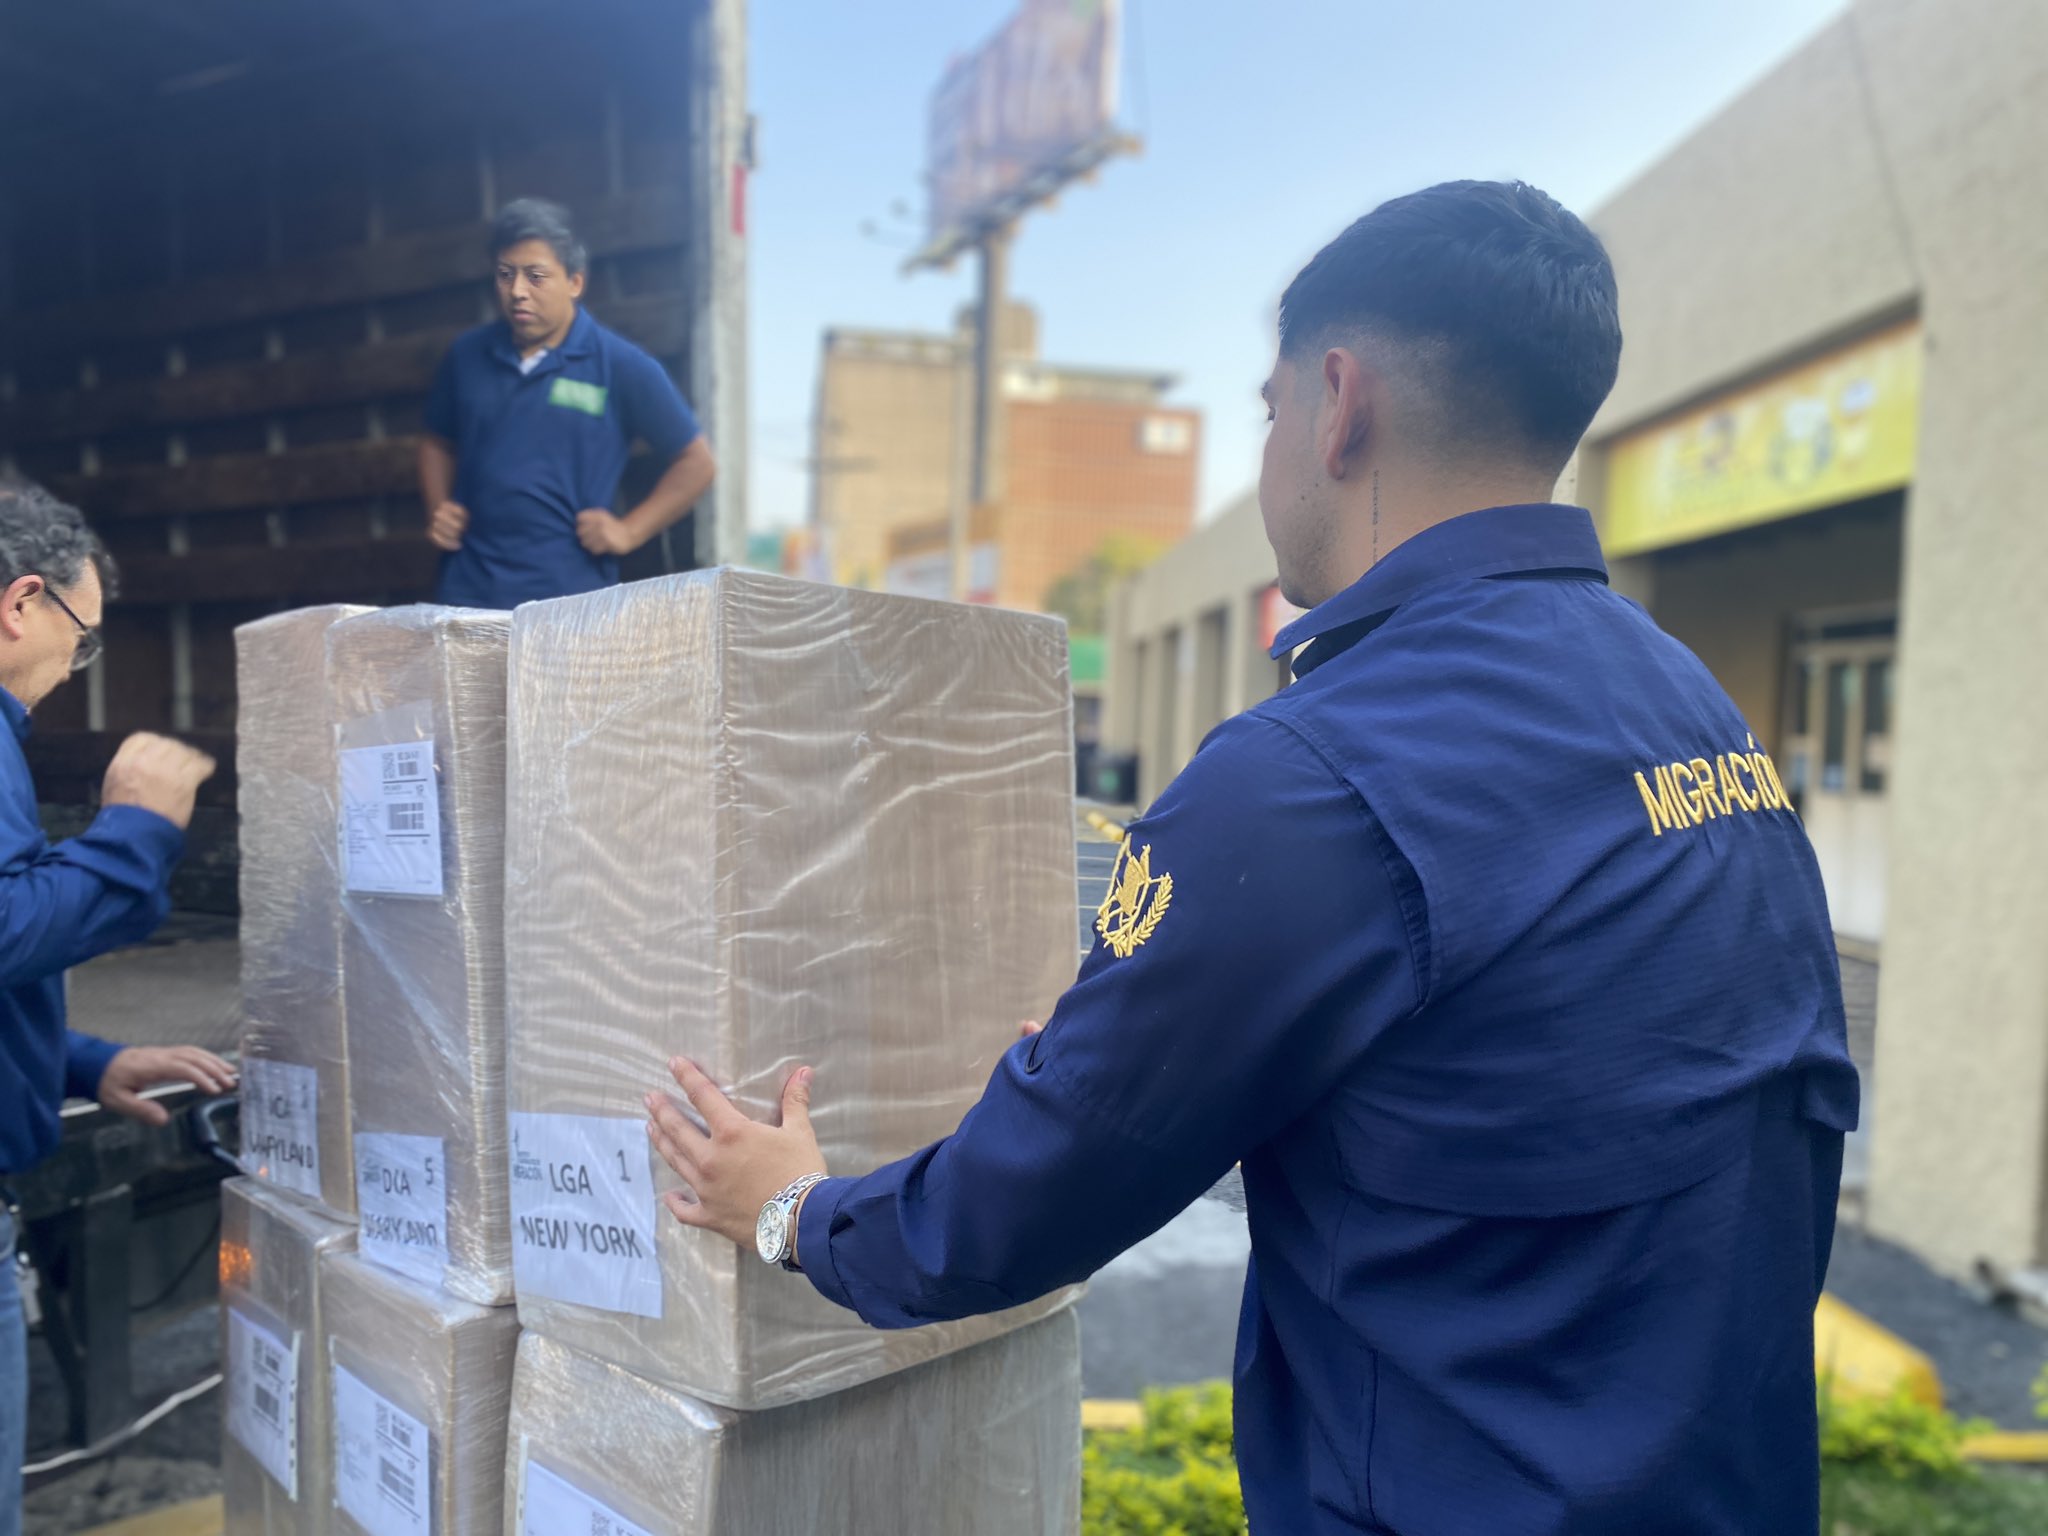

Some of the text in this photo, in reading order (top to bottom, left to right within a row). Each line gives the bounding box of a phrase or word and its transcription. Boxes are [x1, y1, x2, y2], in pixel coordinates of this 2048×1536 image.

[382, 1168, 412, 1197] DCA
[424, 1157, 434, 1186] 5
[549, 1149, 631, 1196] LGA 1
[520, 1216, 642, 1259] NEW YORK
